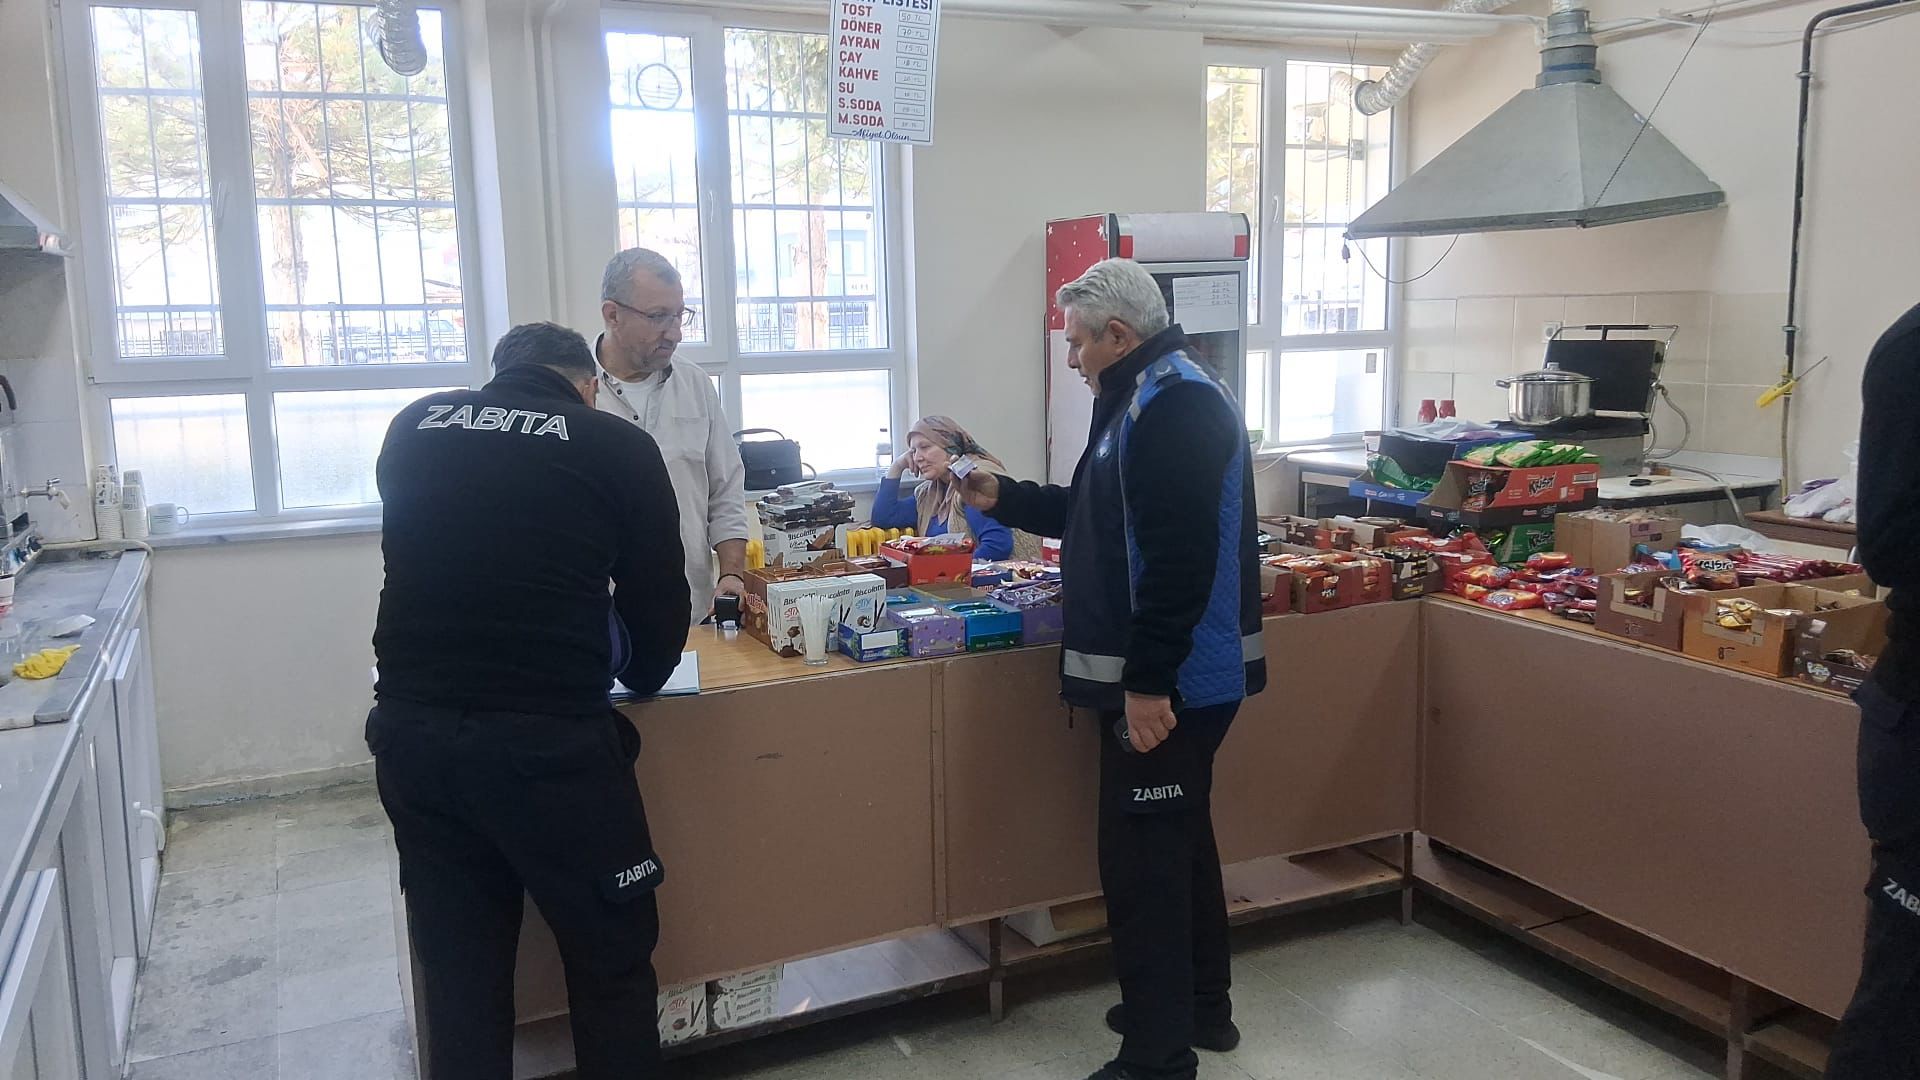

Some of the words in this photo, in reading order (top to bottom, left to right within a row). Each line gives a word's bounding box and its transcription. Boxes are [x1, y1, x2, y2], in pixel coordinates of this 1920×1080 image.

[841, 2, 873, 17] TOST
[840, 16, 882, 35] DÖNER
[839, 34, 880, 51] AYRAN
[839, 50, 863, 66] ÇAY
[838, 66, 879, 81] KAHVE
[838, 81, 855, 94] SU
[838, 97, 882, 112] S.SODA
[838, 112, 884, 127] M.SODA
[852, 127, 883, 140] Afiyet
[884, 129, 910, 141] Olsun
[417, 404, 569, 441] ZABITA
[1132, 784, 1184, 801] ZABITA
[615, 858, 658, 889] ZABITA
[1882, 877, 1920, 916] ZAB
